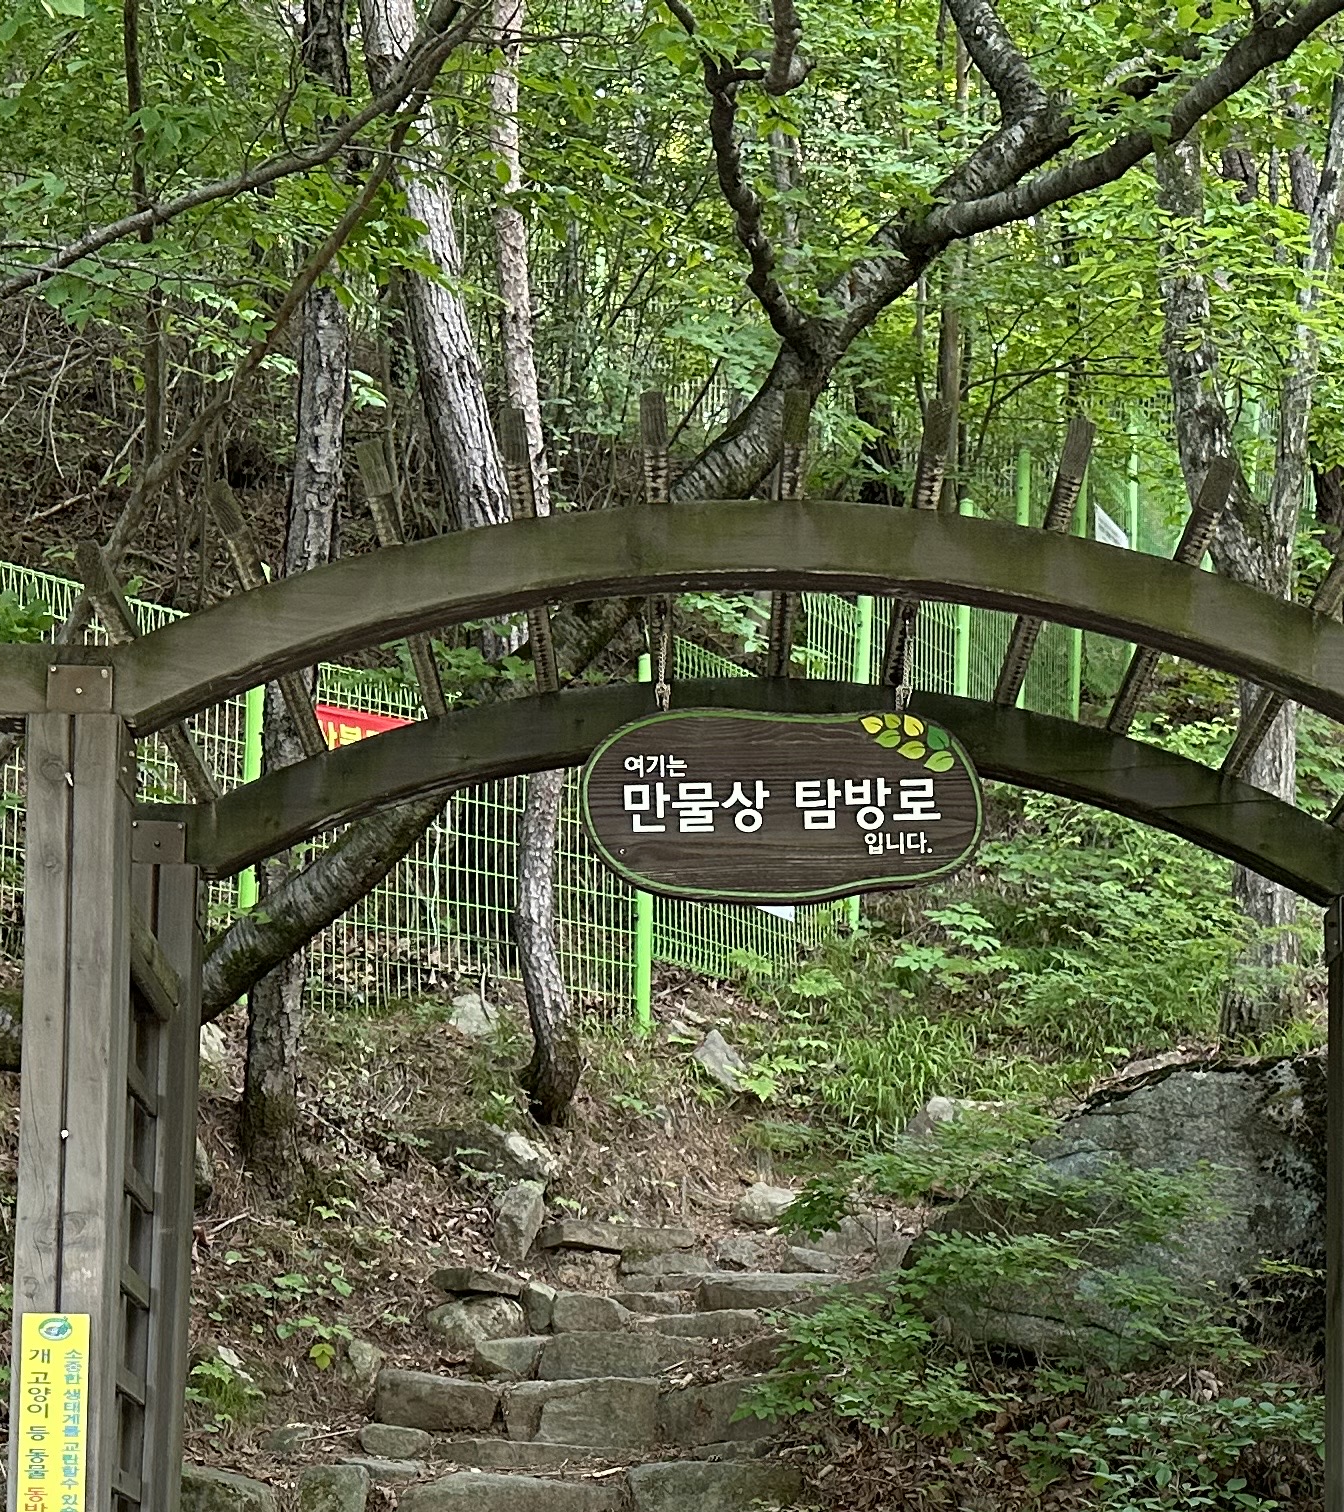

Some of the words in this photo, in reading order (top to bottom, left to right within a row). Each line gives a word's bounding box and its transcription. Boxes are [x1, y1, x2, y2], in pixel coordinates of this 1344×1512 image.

[624, 755, 687, 778] 여기는
[623, 780, 770, 833] 만물상
[795, 778, 942, 831] 탐방로
[864, 832, 933, 855] 입니다.
[29, 1349, 51, 1364] 개
[64, 1349, 83, 1385] 소중한
[27, 1372, 51, 1418] 고양이
[26, 1426, 50, 1441] 등
[24, 1449, 49, 1479] 동물
